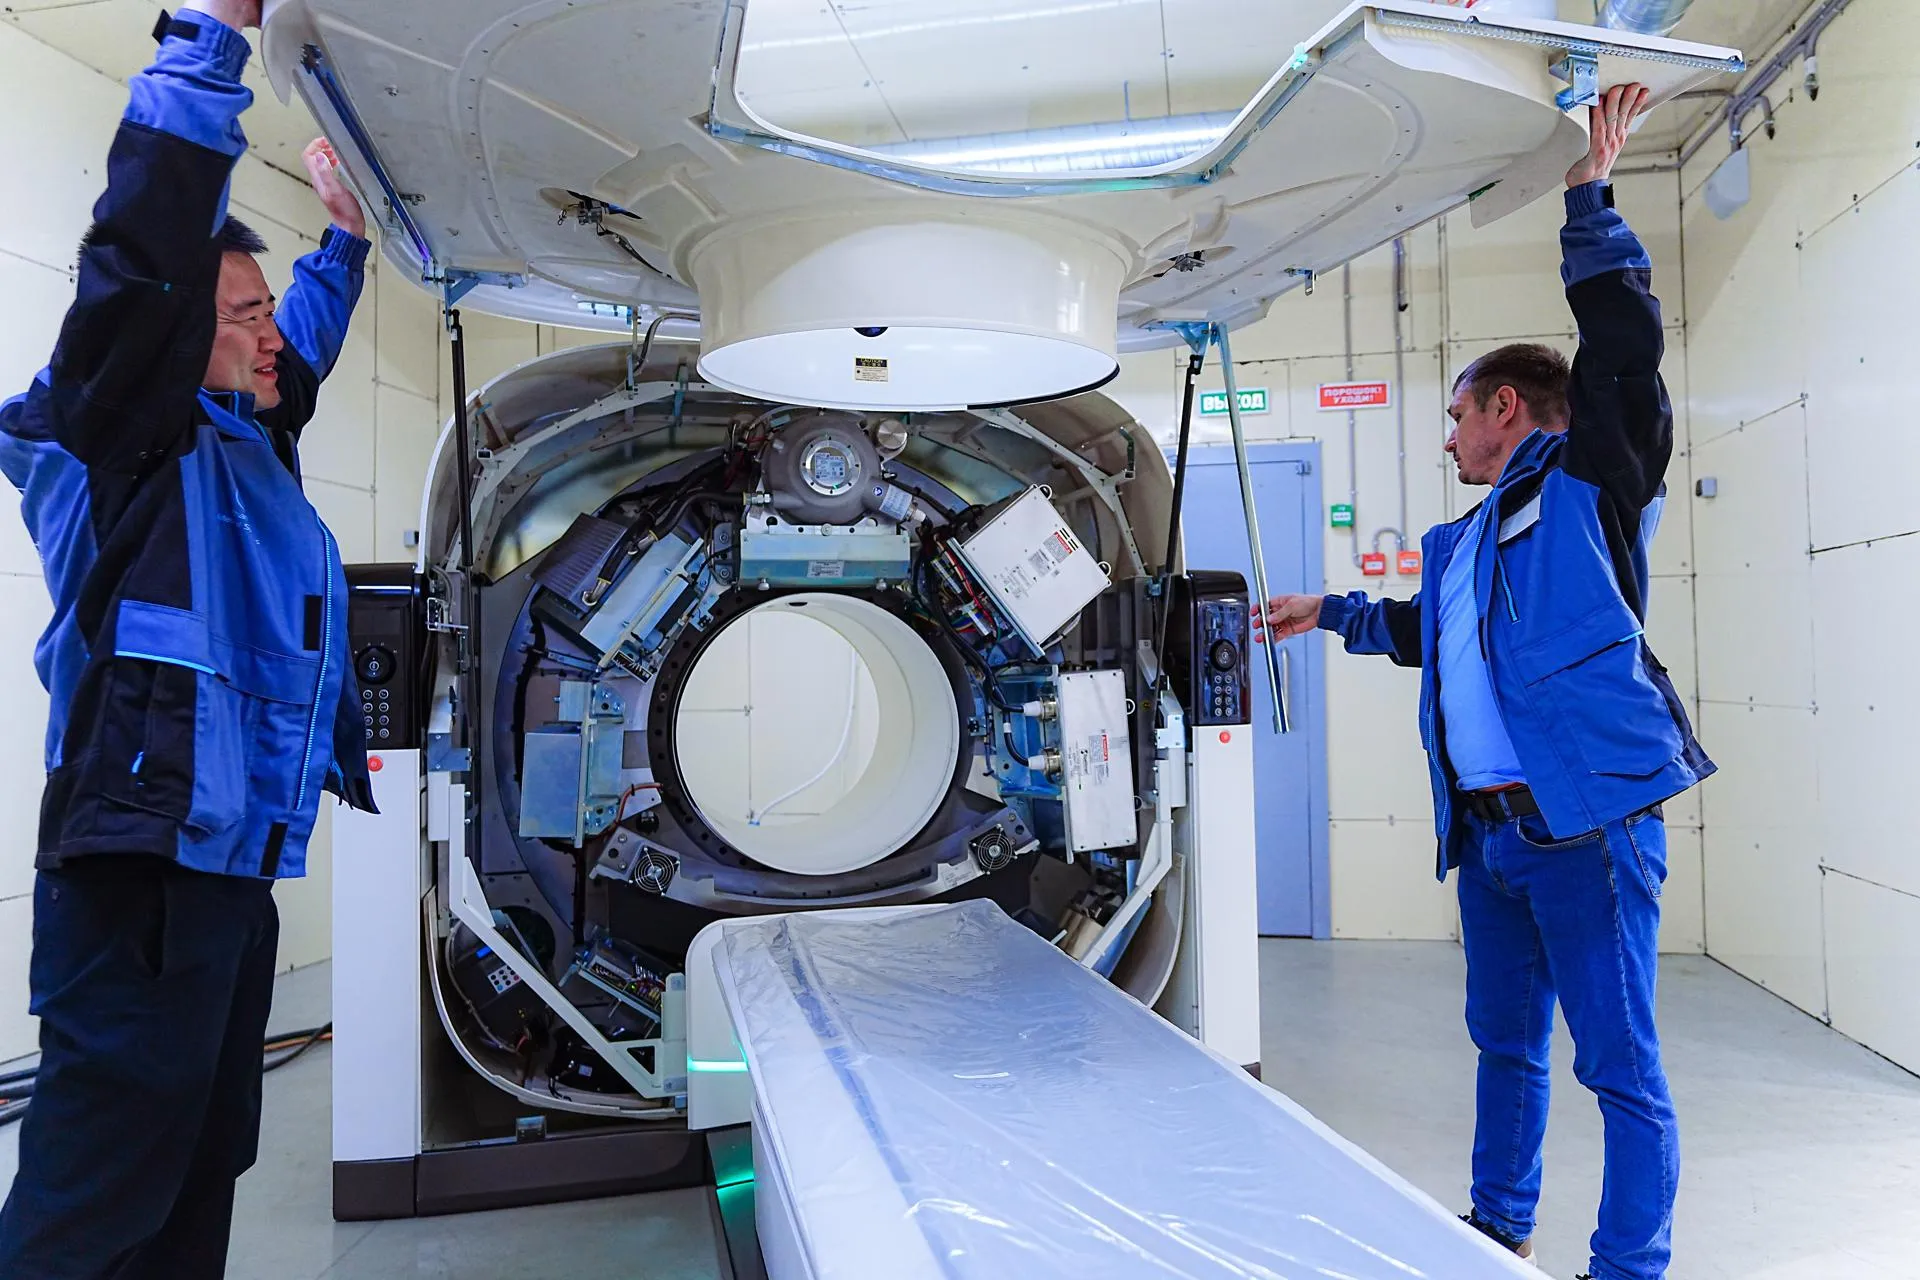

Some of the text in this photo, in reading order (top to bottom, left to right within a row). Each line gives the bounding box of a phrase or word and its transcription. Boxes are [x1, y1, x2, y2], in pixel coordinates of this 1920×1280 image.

[1324, 387, 1382, 397] ПОРОШОК!
[1203, 393, 1264, 411] ВЫОД
[1333, 395, 1374, 404] УХОДИ!
